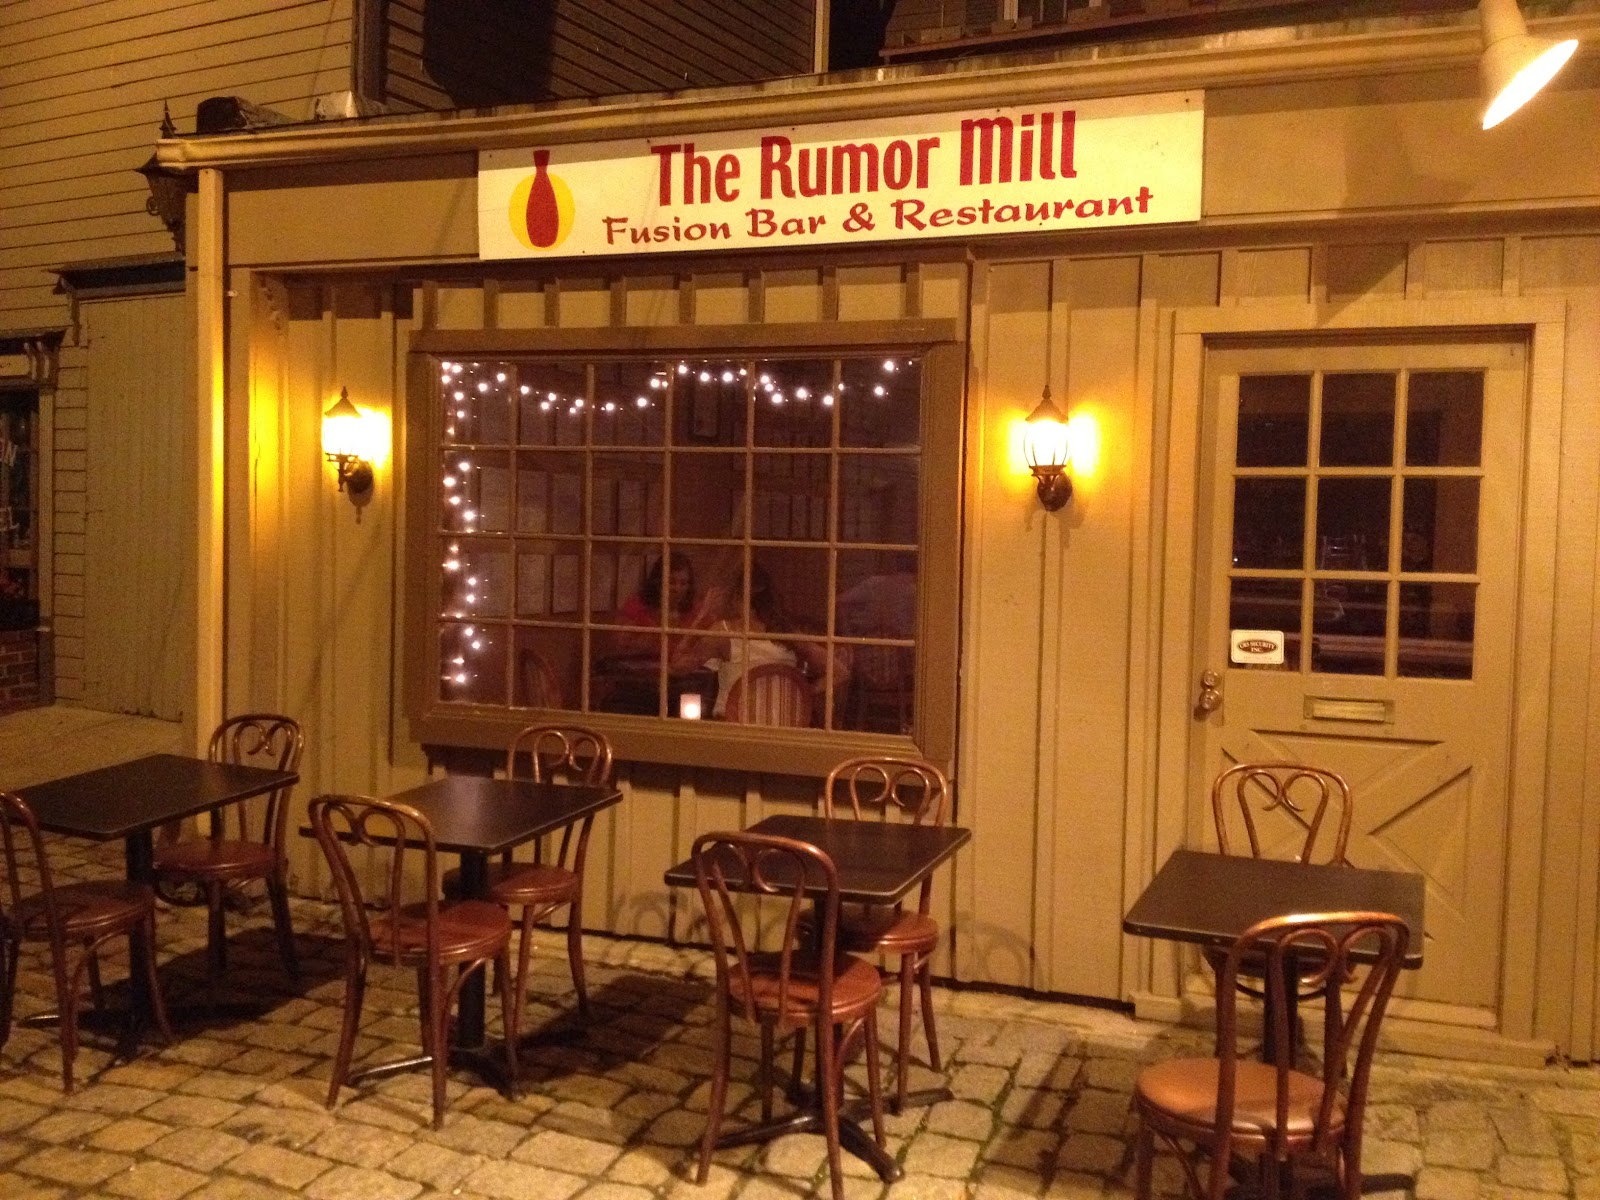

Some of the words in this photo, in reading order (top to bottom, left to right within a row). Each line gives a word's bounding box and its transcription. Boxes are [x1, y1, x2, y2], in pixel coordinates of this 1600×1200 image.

[651, 142, 741, 207] The
[759, 135, 940, 200] Rumor
[602, 216, 732, 245] Fusion
[745, 207, 826, 238] Bar
[842, 202, 876, 233] &
[890, 186, 1154, 231] Restaurant
[1250, 641, 1275, 650] SECURITY
